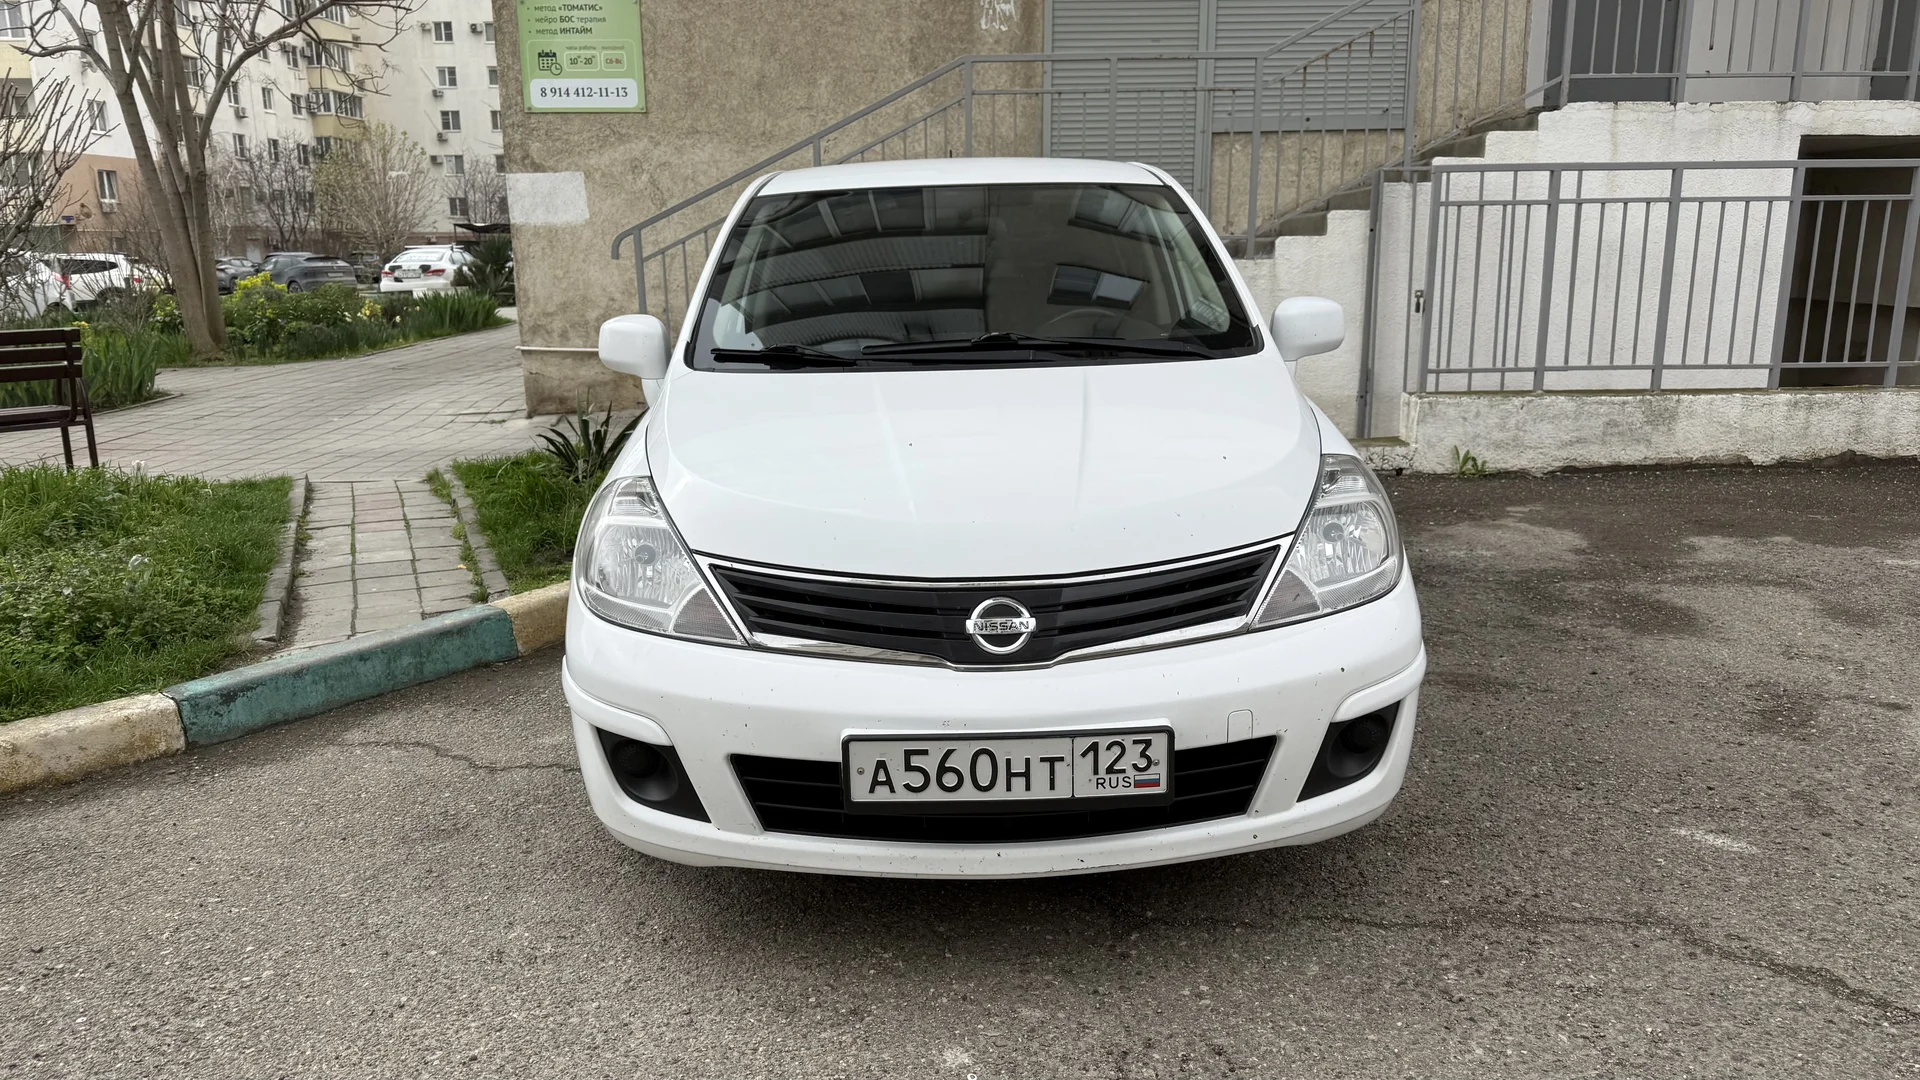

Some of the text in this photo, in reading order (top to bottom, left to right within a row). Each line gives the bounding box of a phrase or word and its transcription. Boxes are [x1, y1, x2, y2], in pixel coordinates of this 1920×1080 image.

[558, 4, 603, 12] «ТОМАТИС»
[535, 16, 557, 24] нейро
[560, 26, 592, 35] ИНТАЙМ
[540, 87, 628, 98] 8 914 412-11-13
[973, 621, 1029, 631] NISSAN
[1079, 738, 1153, 776] 123
[1095, 776, 1132, 790] RUS
